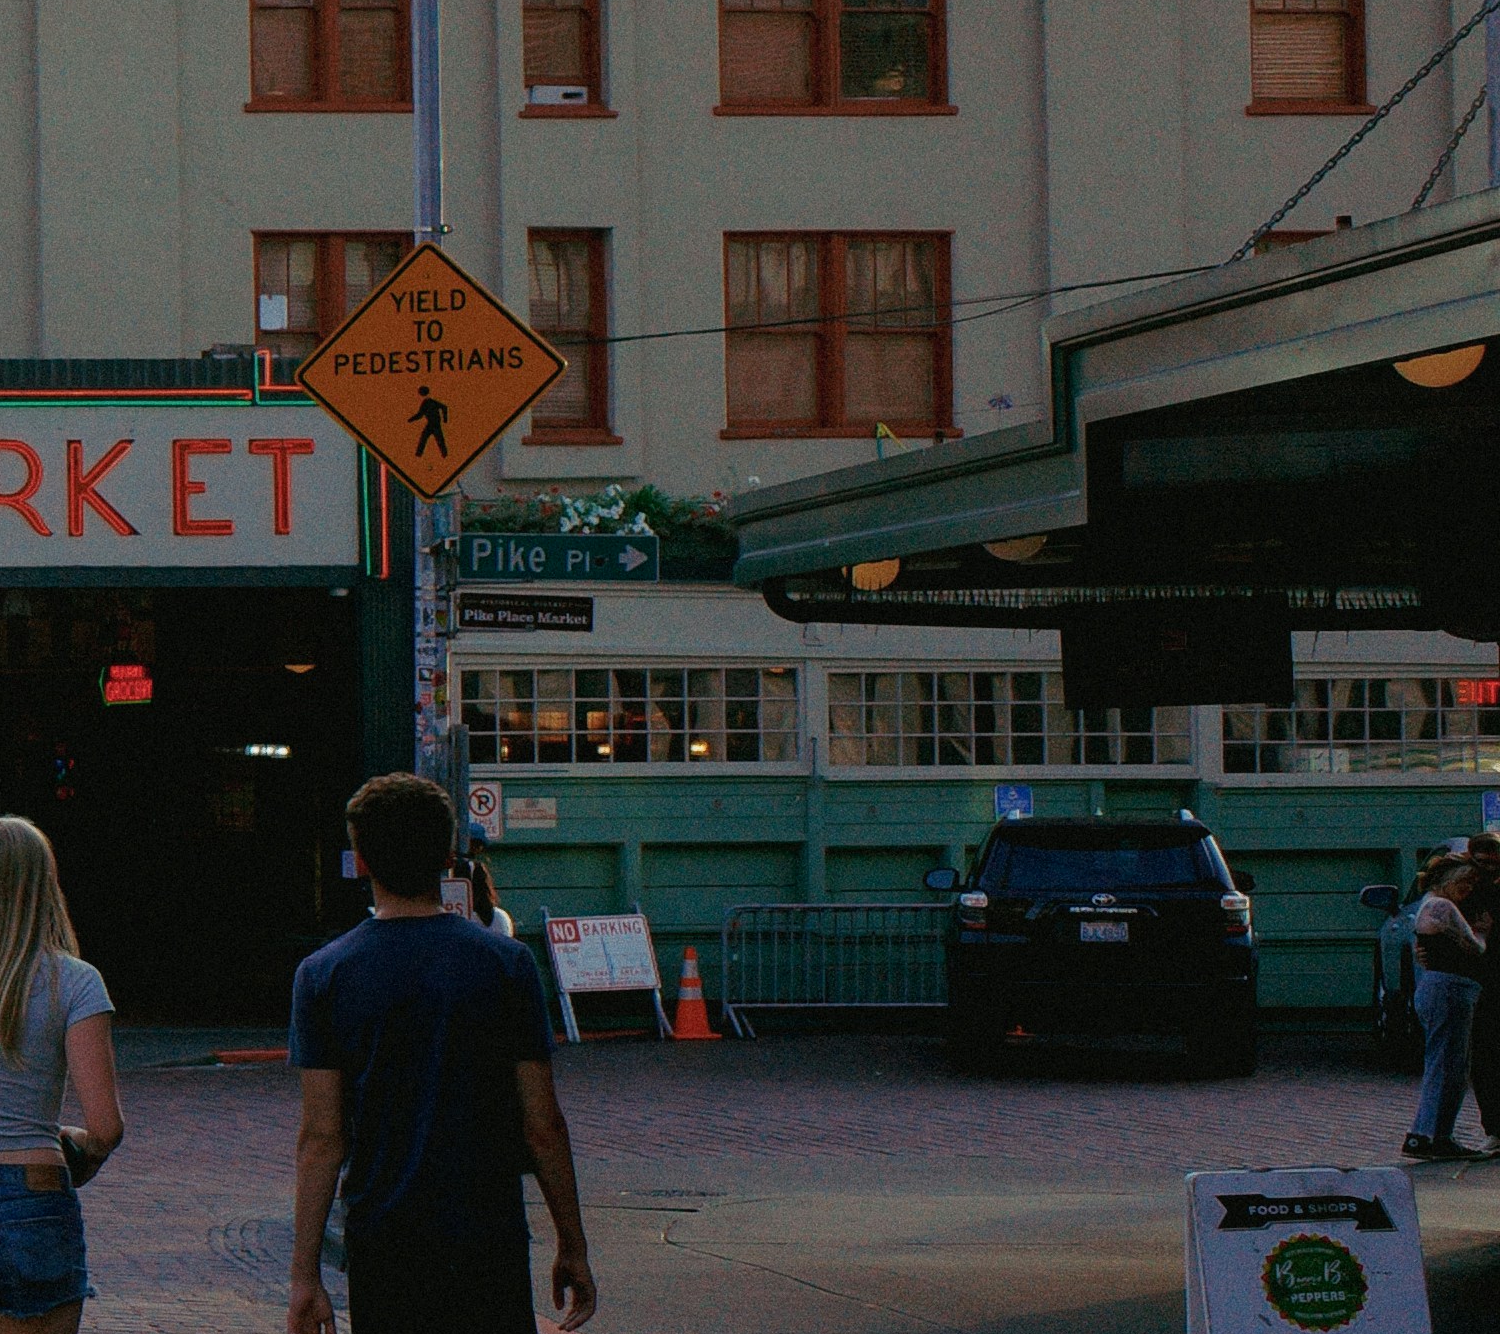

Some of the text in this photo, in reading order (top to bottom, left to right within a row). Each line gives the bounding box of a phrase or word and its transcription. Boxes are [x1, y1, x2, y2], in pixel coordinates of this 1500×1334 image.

[390, 289, 466, 313] YIELD
[413, 320, 443, 342] TO
[335, 346, 523, 376] PEDESTRIANS
[471, 538, 547, 573] Pike
[464, 609, 588, 624] Pike Place Market
[551, 920, 642, 941] NO PARKING
[1248, 1202, 1358, 1216] FOOD & SHOPS
[1290, 1291, 1346, 1303] PEPPERS
